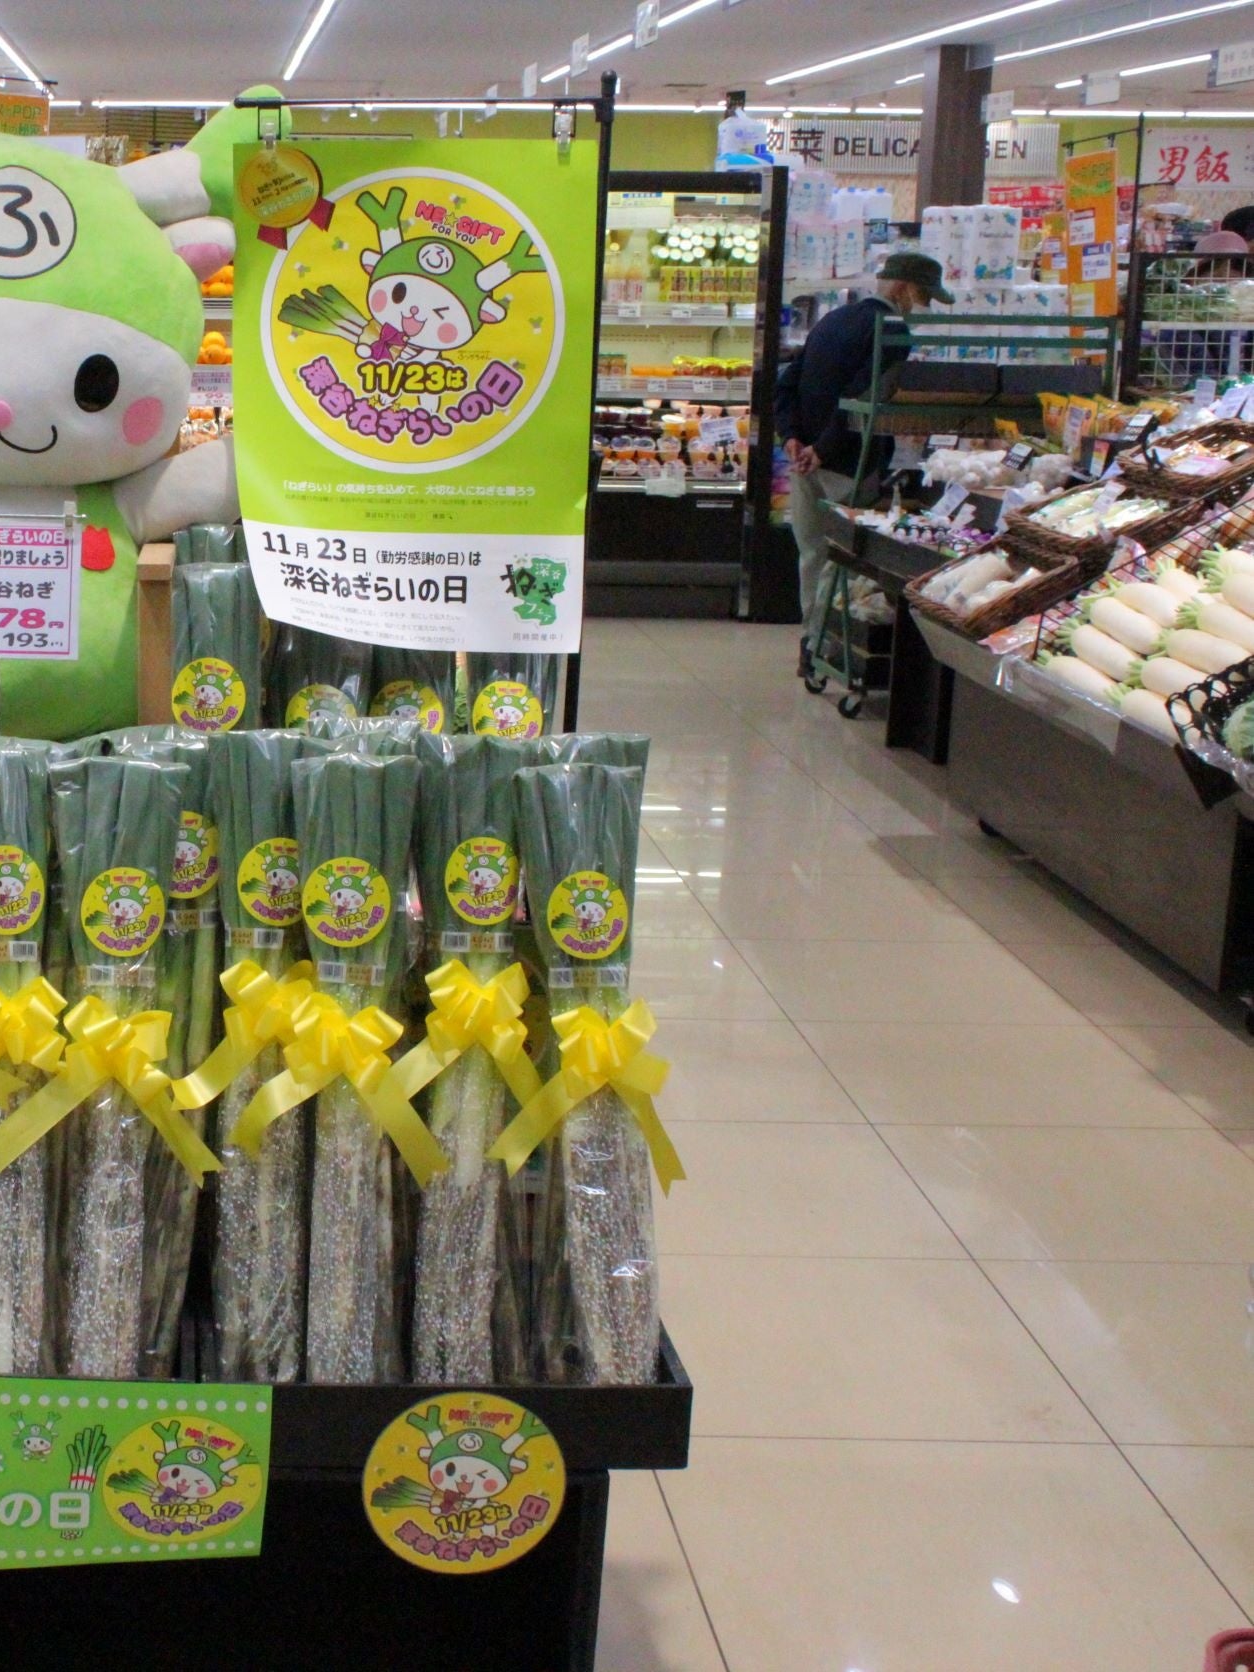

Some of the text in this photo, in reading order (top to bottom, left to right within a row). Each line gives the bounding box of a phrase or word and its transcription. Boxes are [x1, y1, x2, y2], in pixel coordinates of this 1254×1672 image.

[1158, 145, 1230, 184] 男飯
[432, 224, 476, 244] FOR YOU
[358, 361, 467, 397] 11/23は
[300, 356, 524, 444] 深谷ねぎらいの日
[280, 562, 468, 604] 深谷ねぎらいの日
